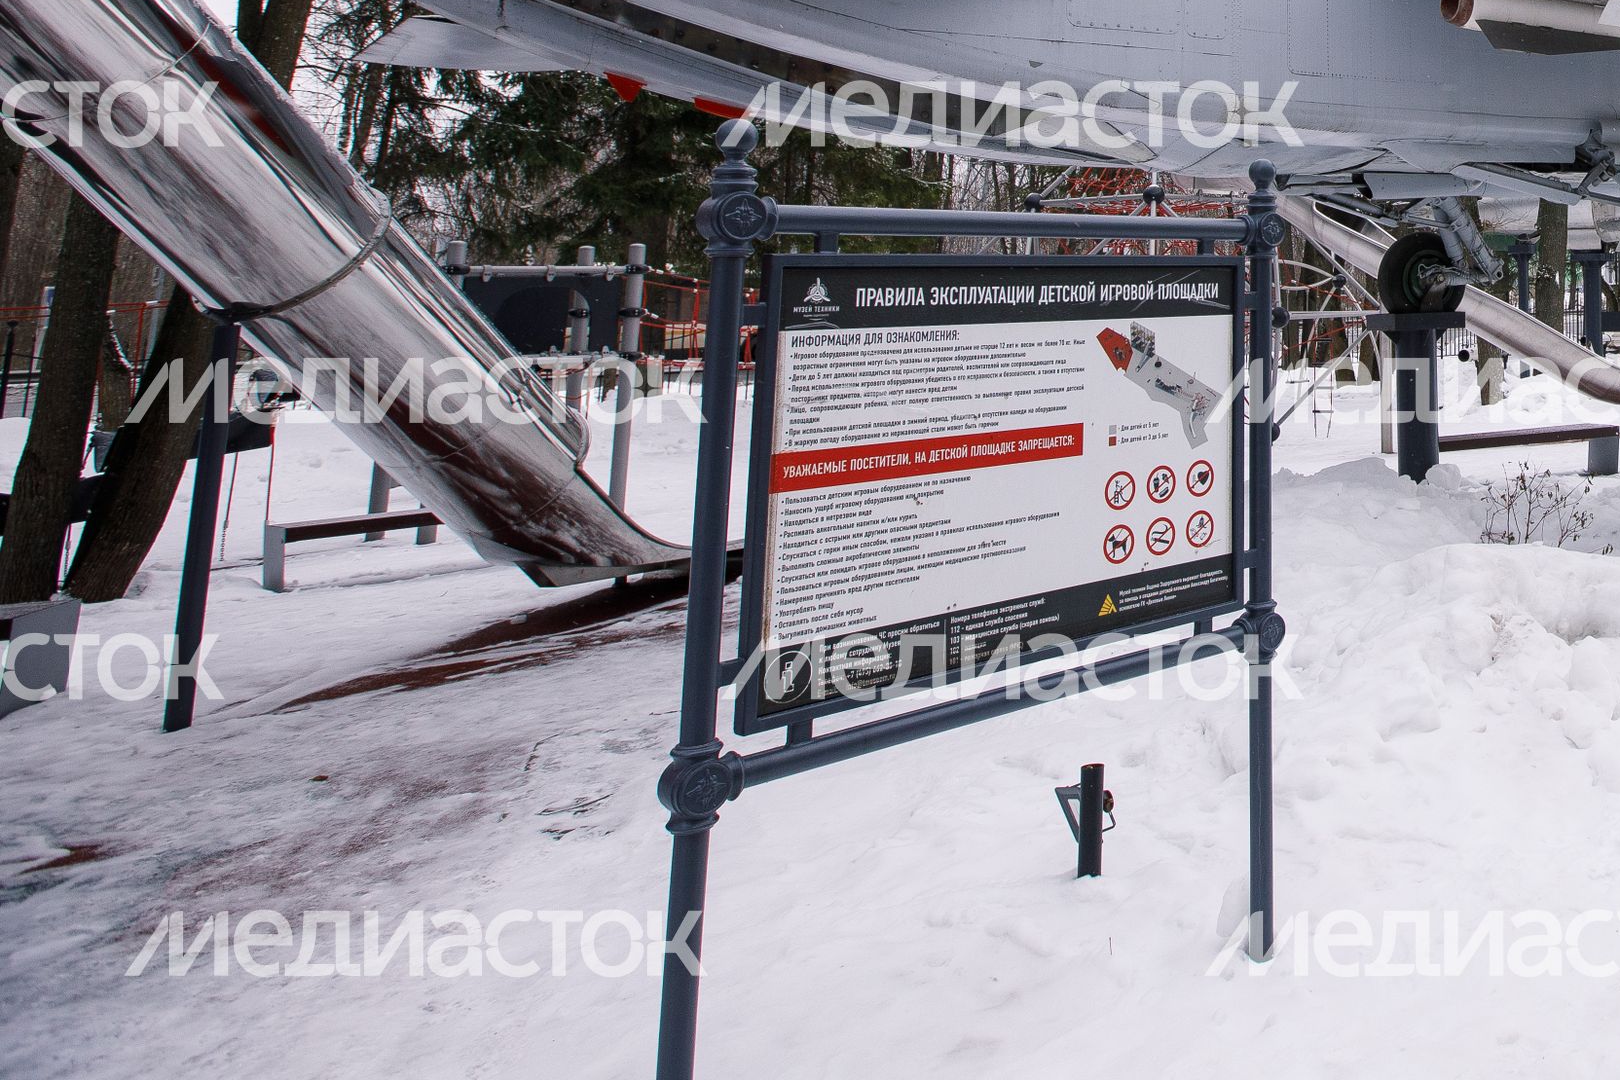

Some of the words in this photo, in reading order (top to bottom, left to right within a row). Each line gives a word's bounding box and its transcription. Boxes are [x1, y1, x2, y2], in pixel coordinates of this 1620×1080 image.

[856, 287, 924, 307] ПРАВИЛА
[930, 285, 1034, 305] ЭКСПЛУАТАЦИИ
[1040, 282, 1095, 305] ДЕТСКОЙ
[1100, 281, 1153, 301] ИГРОВОЙ
[1158, 282, 1218, 301] ПЛОЩАДКИ
[791, 333, 861, 347] ИНФОРМАЦИЯ
[864, 332, 882, 346] ДЛЯ
[886, 329, 959, 343] ОЗНАКОМЛЕНИЯ:
[783, 459, 847, 478] УВАЖАЕМЫЕ
[850, 453, 911, 470] ПОСЕТИТЕЛИ,
[915, 451, 926, 463] НА
[928, 444, 967, 463] ДЕТСКОЙ
[970, 441, 1015, 456] ПЛОЩАДКЕ
[1018, 434, 1074, 451] ЗАПРЕЩАЕТСЯ:
